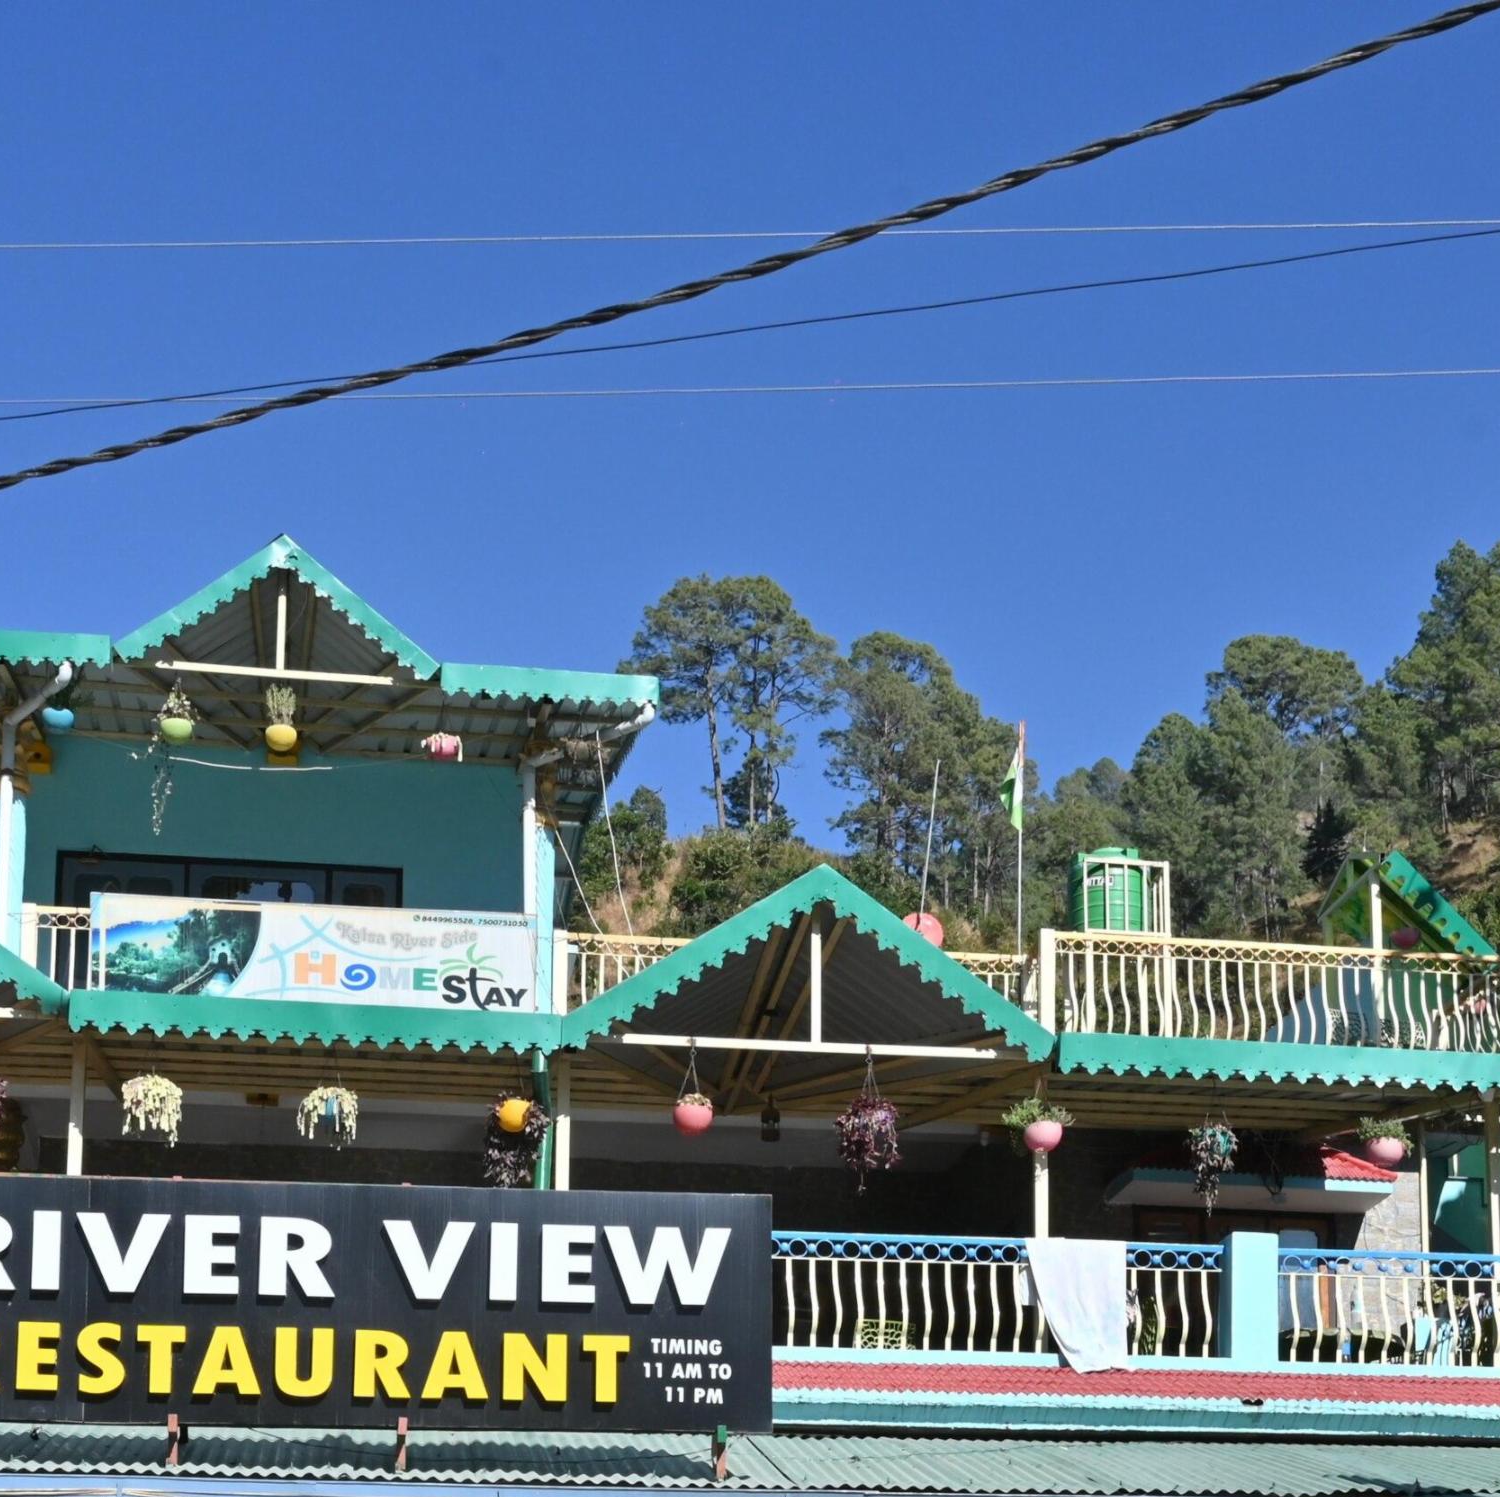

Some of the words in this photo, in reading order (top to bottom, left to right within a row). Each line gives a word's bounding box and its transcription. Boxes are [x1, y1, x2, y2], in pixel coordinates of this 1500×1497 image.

[390, 931, 436, 951] River
[441, 930, 478, 948] Side
[381, 1219, 733, 1309] VIEW
[650, 1337, 723, 1356] TIMING
[643, 1362, 659, 1378] 11
[671, 1362, 702, 1379] AM
[708, 1363, 733, 1380] TO
[665, 1386, 681, 1403] 11
[694, 1387, 724, 1404] PM
